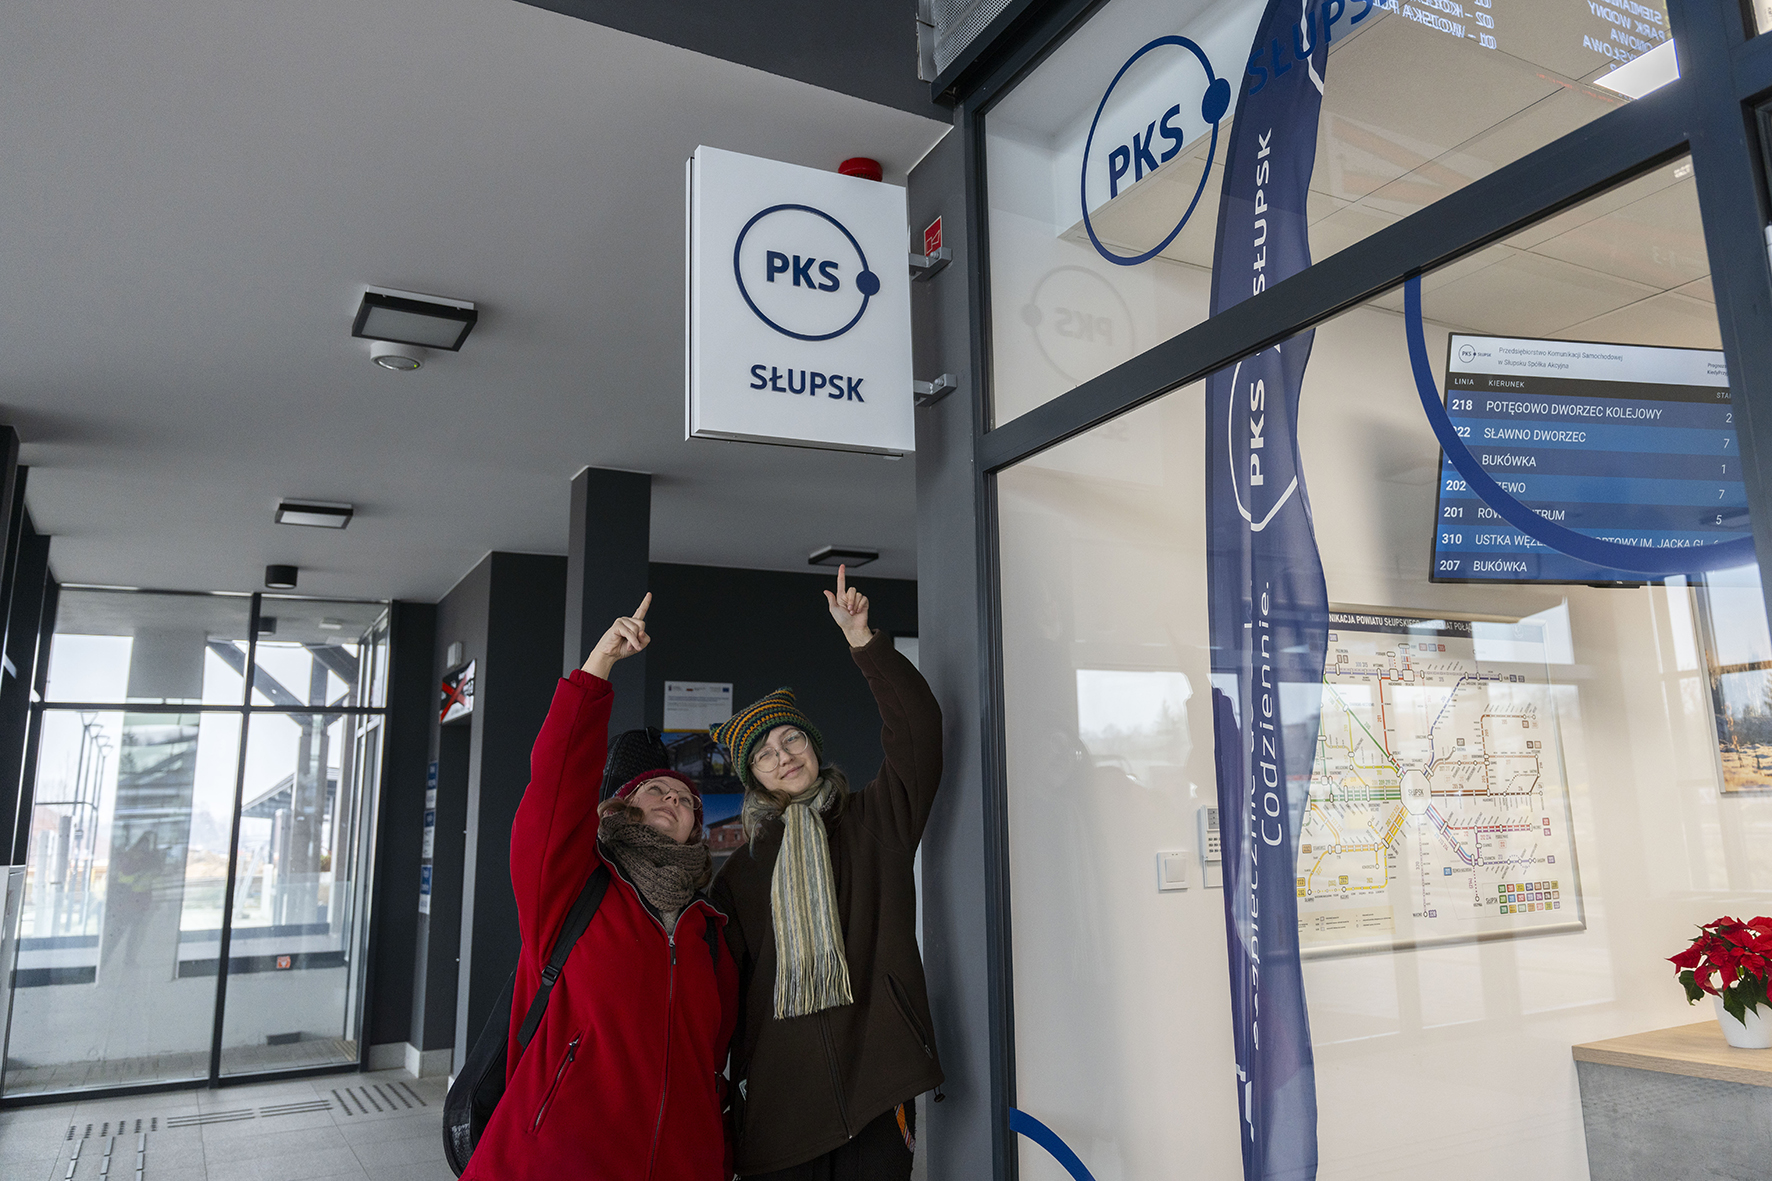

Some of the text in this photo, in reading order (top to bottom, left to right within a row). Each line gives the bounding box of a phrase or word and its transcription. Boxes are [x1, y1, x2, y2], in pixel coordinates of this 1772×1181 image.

[1108, 103, 1184, 200] PKS
[1253, 127, 1273, 296] SŁUPSK
[766, 250, 841, 293] PKS
[1547, 350, 1581, 359] Komunikacji
[1581, 352, 1623, 362] Samochodowej
[749, 364, 865, 403] SŁUPSK
[1454, 378, 1475, 386] LINIA
[1488, 379, 1525, 388] KIERUNEK
[1452, 399, 1473, 411] 218
[1486, 400, 1549, 415] POTĘGOWO
[1551, 403, 1604, 417] DWORZEC
[1605, 406, 1663, 420] KOLEJOWY
[1250, 378, 1265, 486] PKS
[1484, 427, 1531, 440] SŁAWNO
[1533, 429, 1587, 442] DWORZEC
[1723, 438, 1730, 449] 7
[1482, 452, 1537, 467] BUKÓWKA
[1445, 479, 1467, 491] 202
[1718, 489, 1725, 499] 7
[1443, 507, 1463, 518] 201
[1532, 509, 1565, 521] TRUM
[1715, 514, 1722, 525] 5
[1441, 533, 1463, 545] 310
[1475, 534, 1511, 546] USTKA
[1657, 538, 1691, 548] JACKA
[1440, 558, 1528, 572] 207 BUKÓWKA
[1329, 613, 1355, 624] NIKACJA
[1356, 615, 1383, 626] POWIATU
[1259, 581, 1283, 846] Codziennie.
